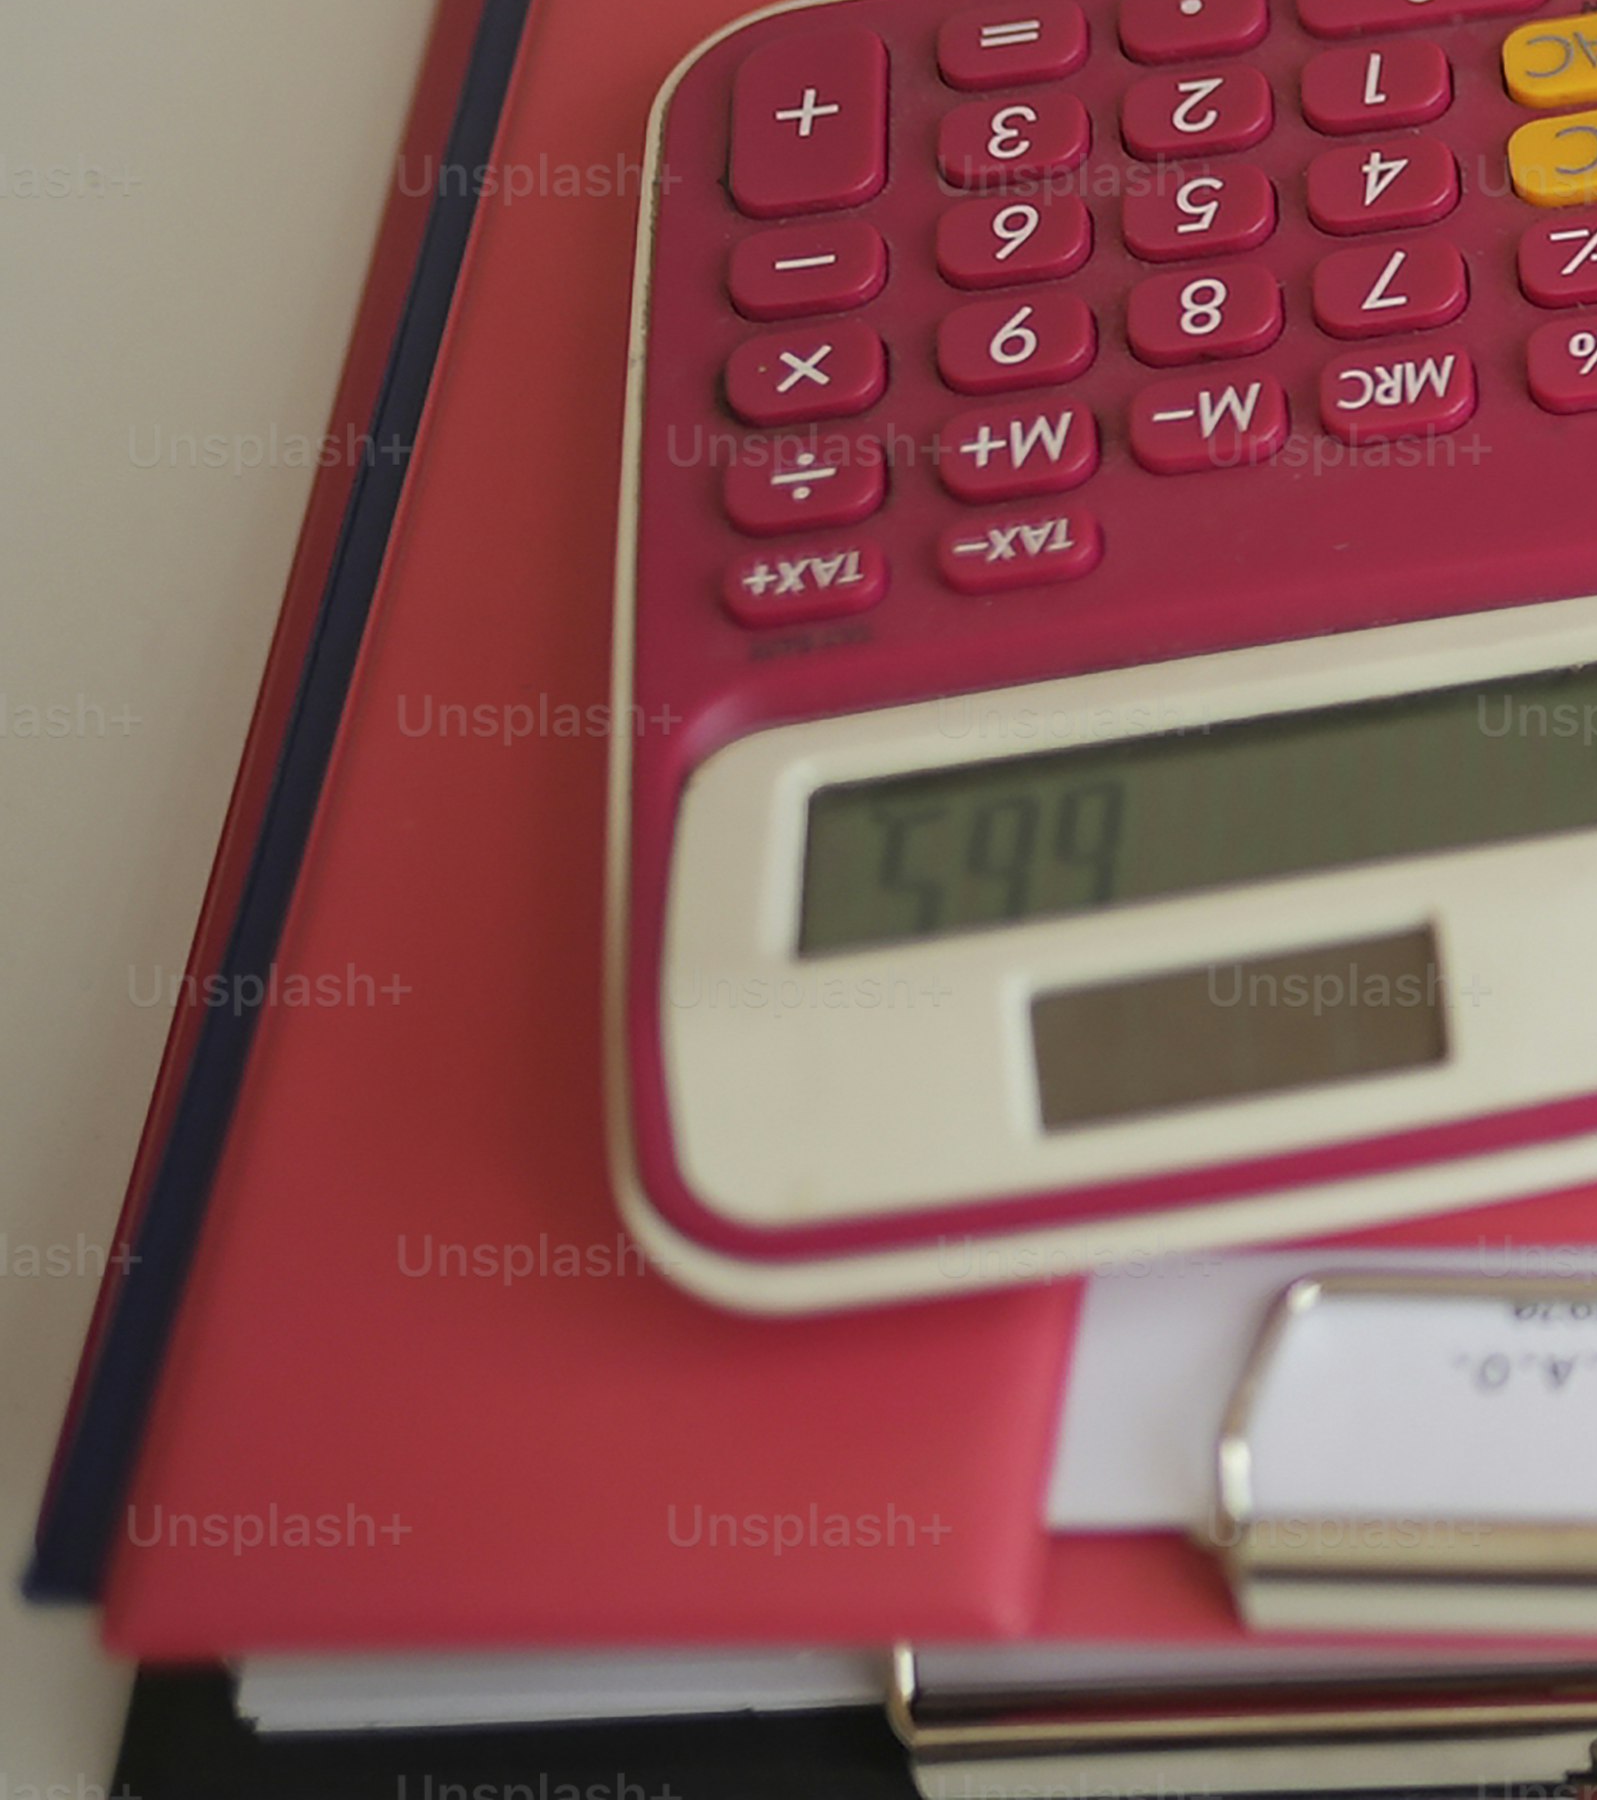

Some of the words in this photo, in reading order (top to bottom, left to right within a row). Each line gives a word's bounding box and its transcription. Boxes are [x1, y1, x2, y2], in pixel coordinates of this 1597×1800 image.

[1173, 78, 1223, 132] 2
[1364, 53, 1386, 104] 1
[988, 106, 1036, 158] 3
[1176, 178, 1223, 233] 5
[1362, 152, 1408, 206] 4
[993, 205, 1039, 260] 6
[1181, 279, 1226, 334] 8
[1361, 251, 1407, 310] 7
[990, 306, 1037, 364] 9
[1152, 382, 1261, 437] M-
[1337, 355, 1455, 409] MRC
[960, 411, 1072, 468] M+
[742, 551, 863, 594] TAX+
